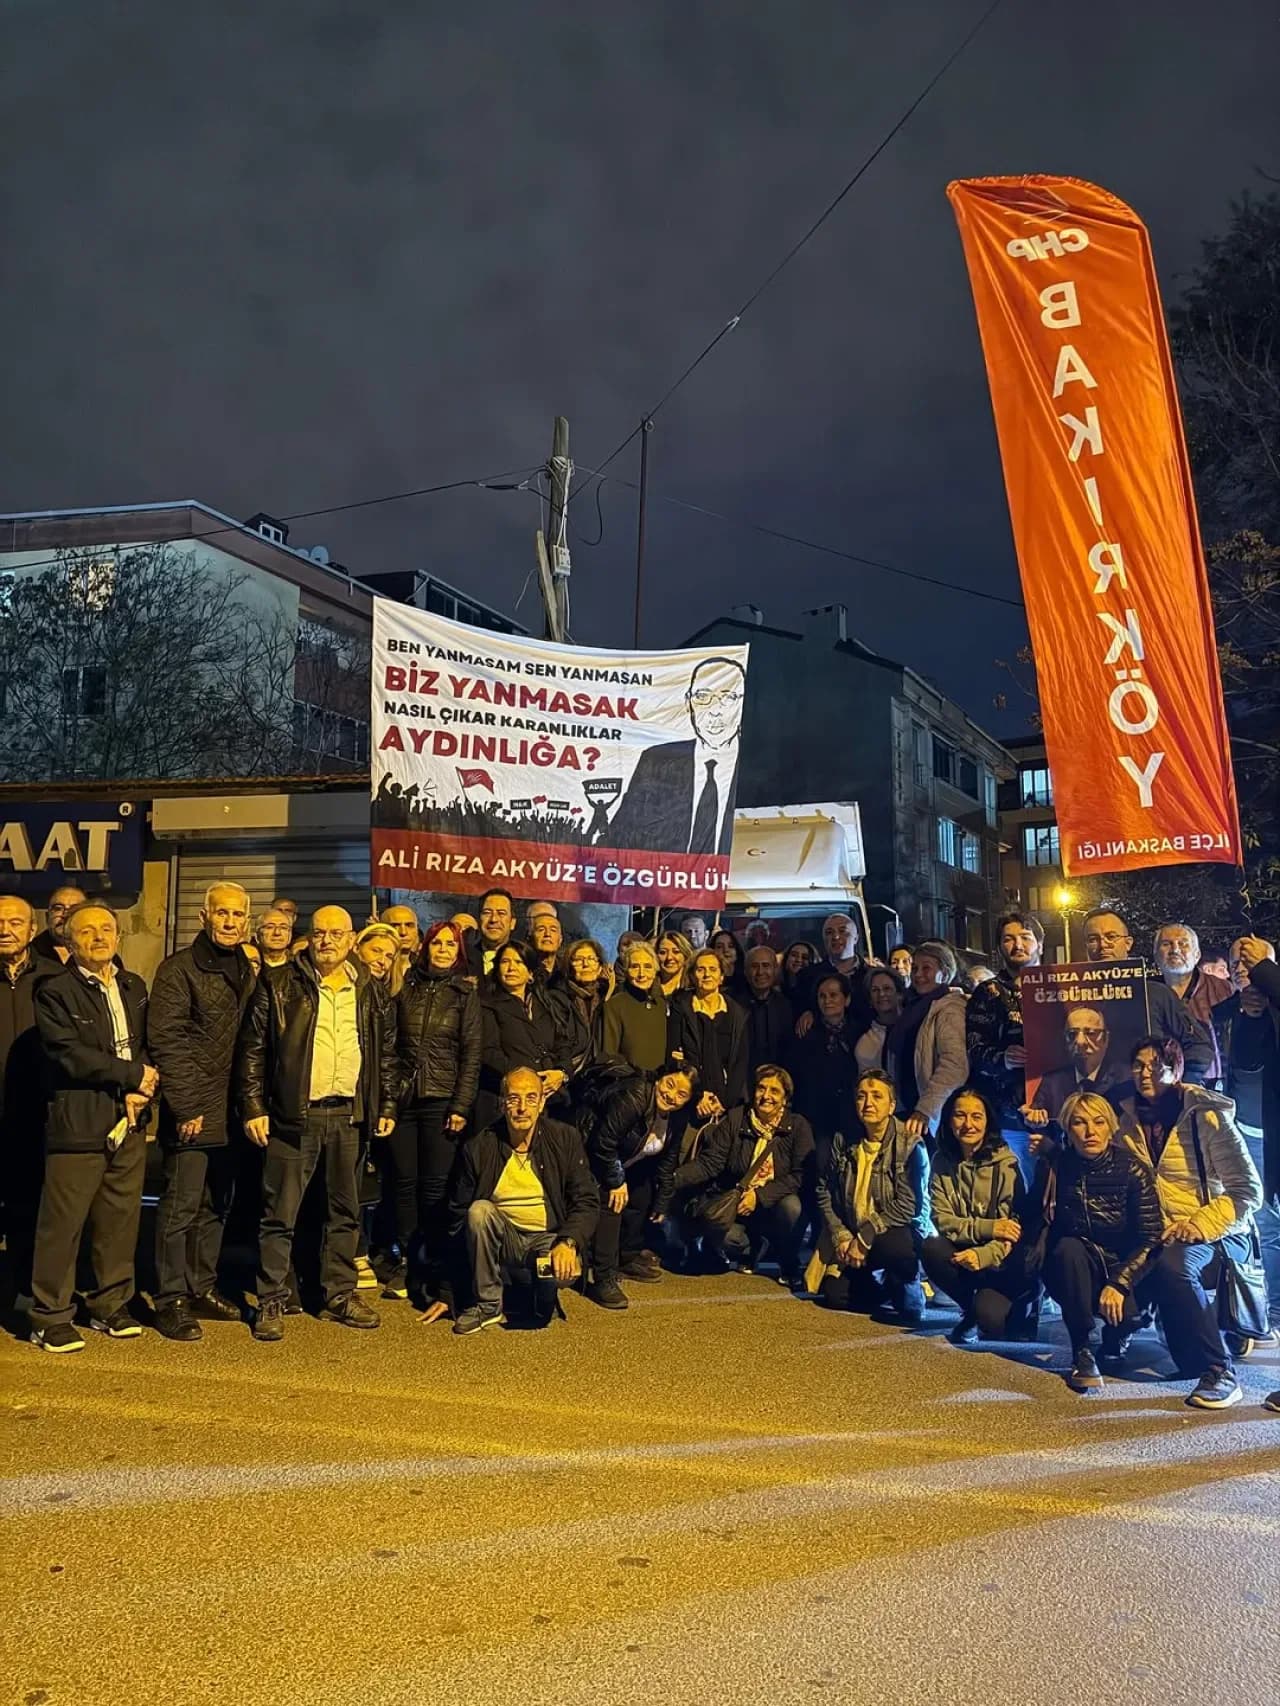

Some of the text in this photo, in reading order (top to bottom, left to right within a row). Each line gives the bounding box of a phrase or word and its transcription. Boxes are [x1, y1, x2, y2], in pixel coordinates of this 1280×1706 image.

[387, 639, 653, 686] BEN YANMASAM SEN YANMASAN
[385, 660, 640, 721] BİZ YANMASAK
[384, 701, 622, 740] NASIL ÇIKAR KARANLIKLAR
[379, 725, 601, 771] AYDINLIĞA?
[378, 845, 419, 869] ALİ
[425, 852, 485, 875] RIZA
[1022, 967, 1142, 984] ALİ RIZA AKYÜZ'E
